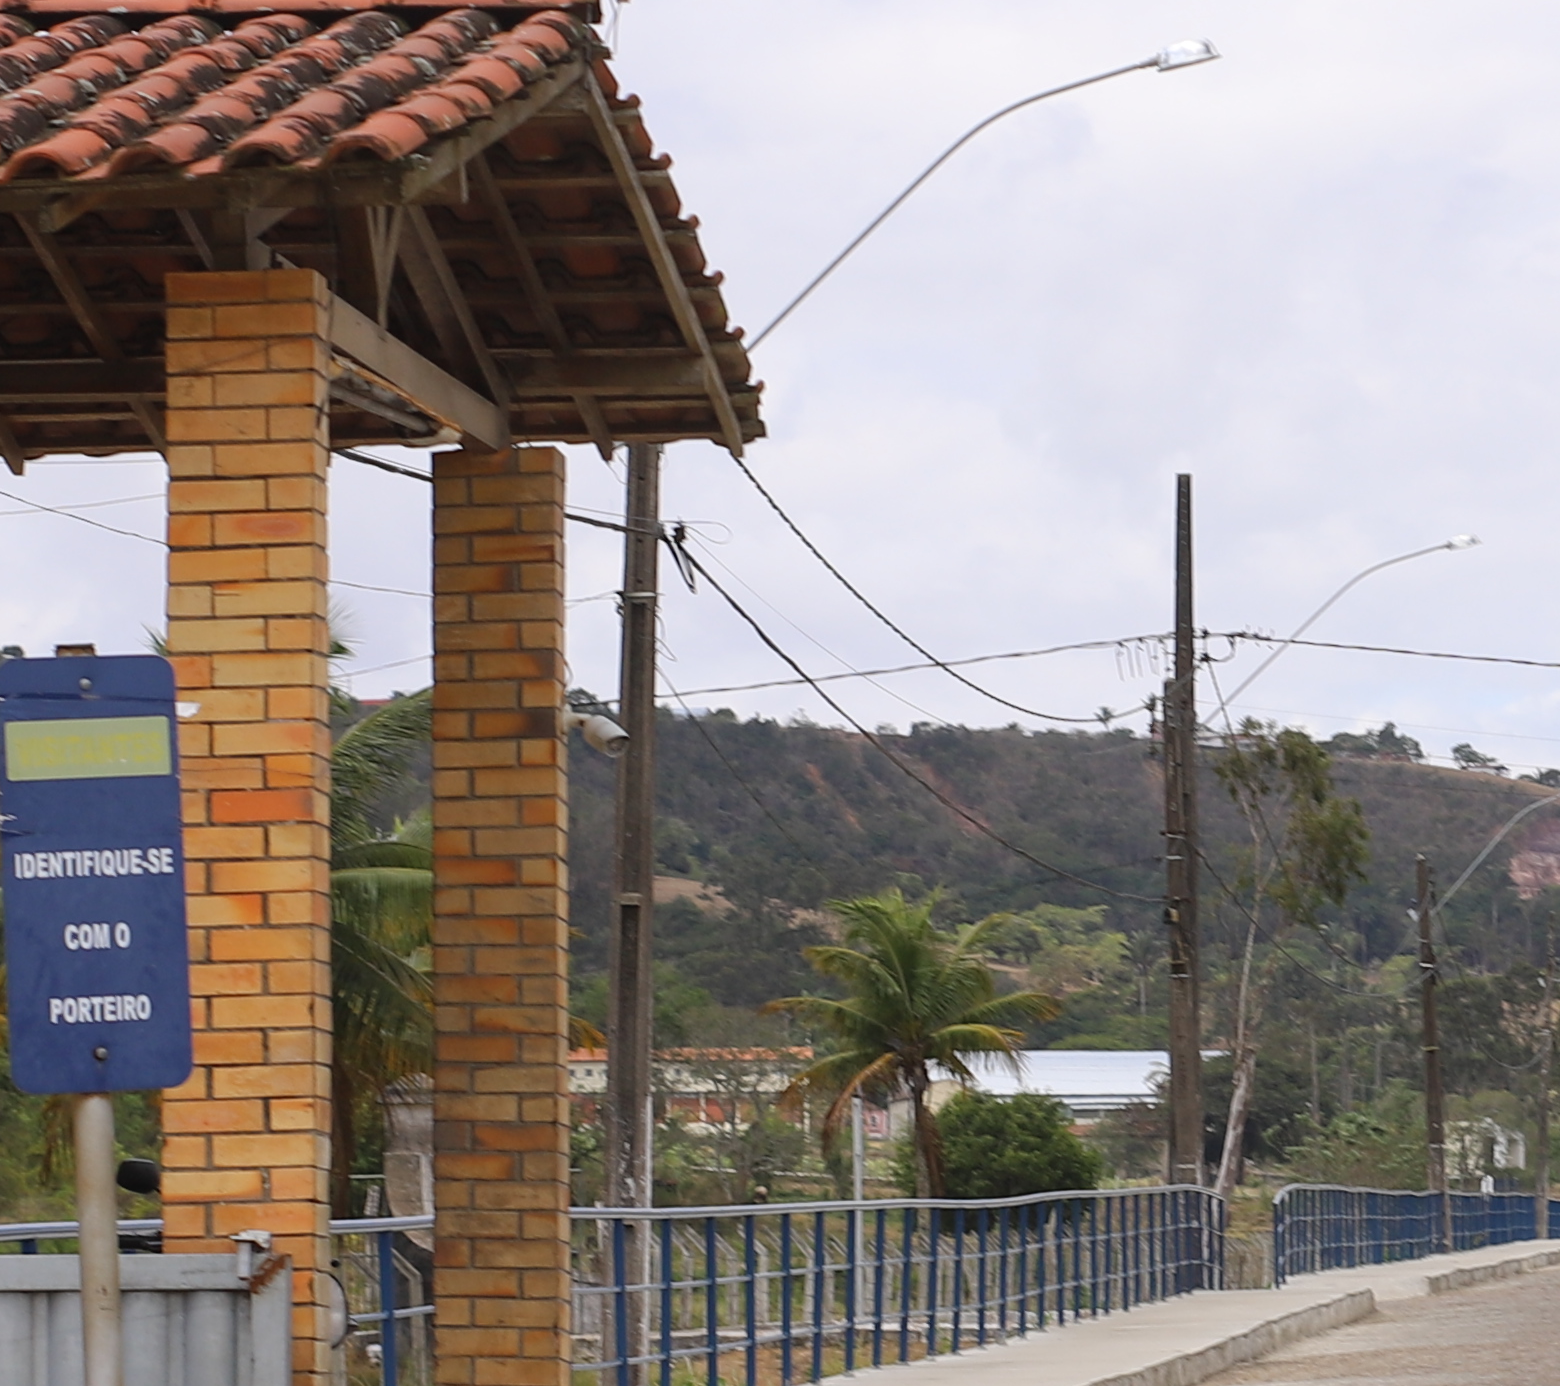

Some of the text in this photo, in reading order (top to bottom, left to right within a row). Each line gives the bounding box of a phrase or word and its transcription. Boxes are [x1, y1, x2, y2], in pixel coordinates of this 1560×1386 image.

[13, 731, 164, 767] VISITANTES
[13, 847, 175, 880] IDENTIFIQUE-SE
[63, 922, 131, 951] COM O
[49, 994, 152, 1024] PORTEIRO
